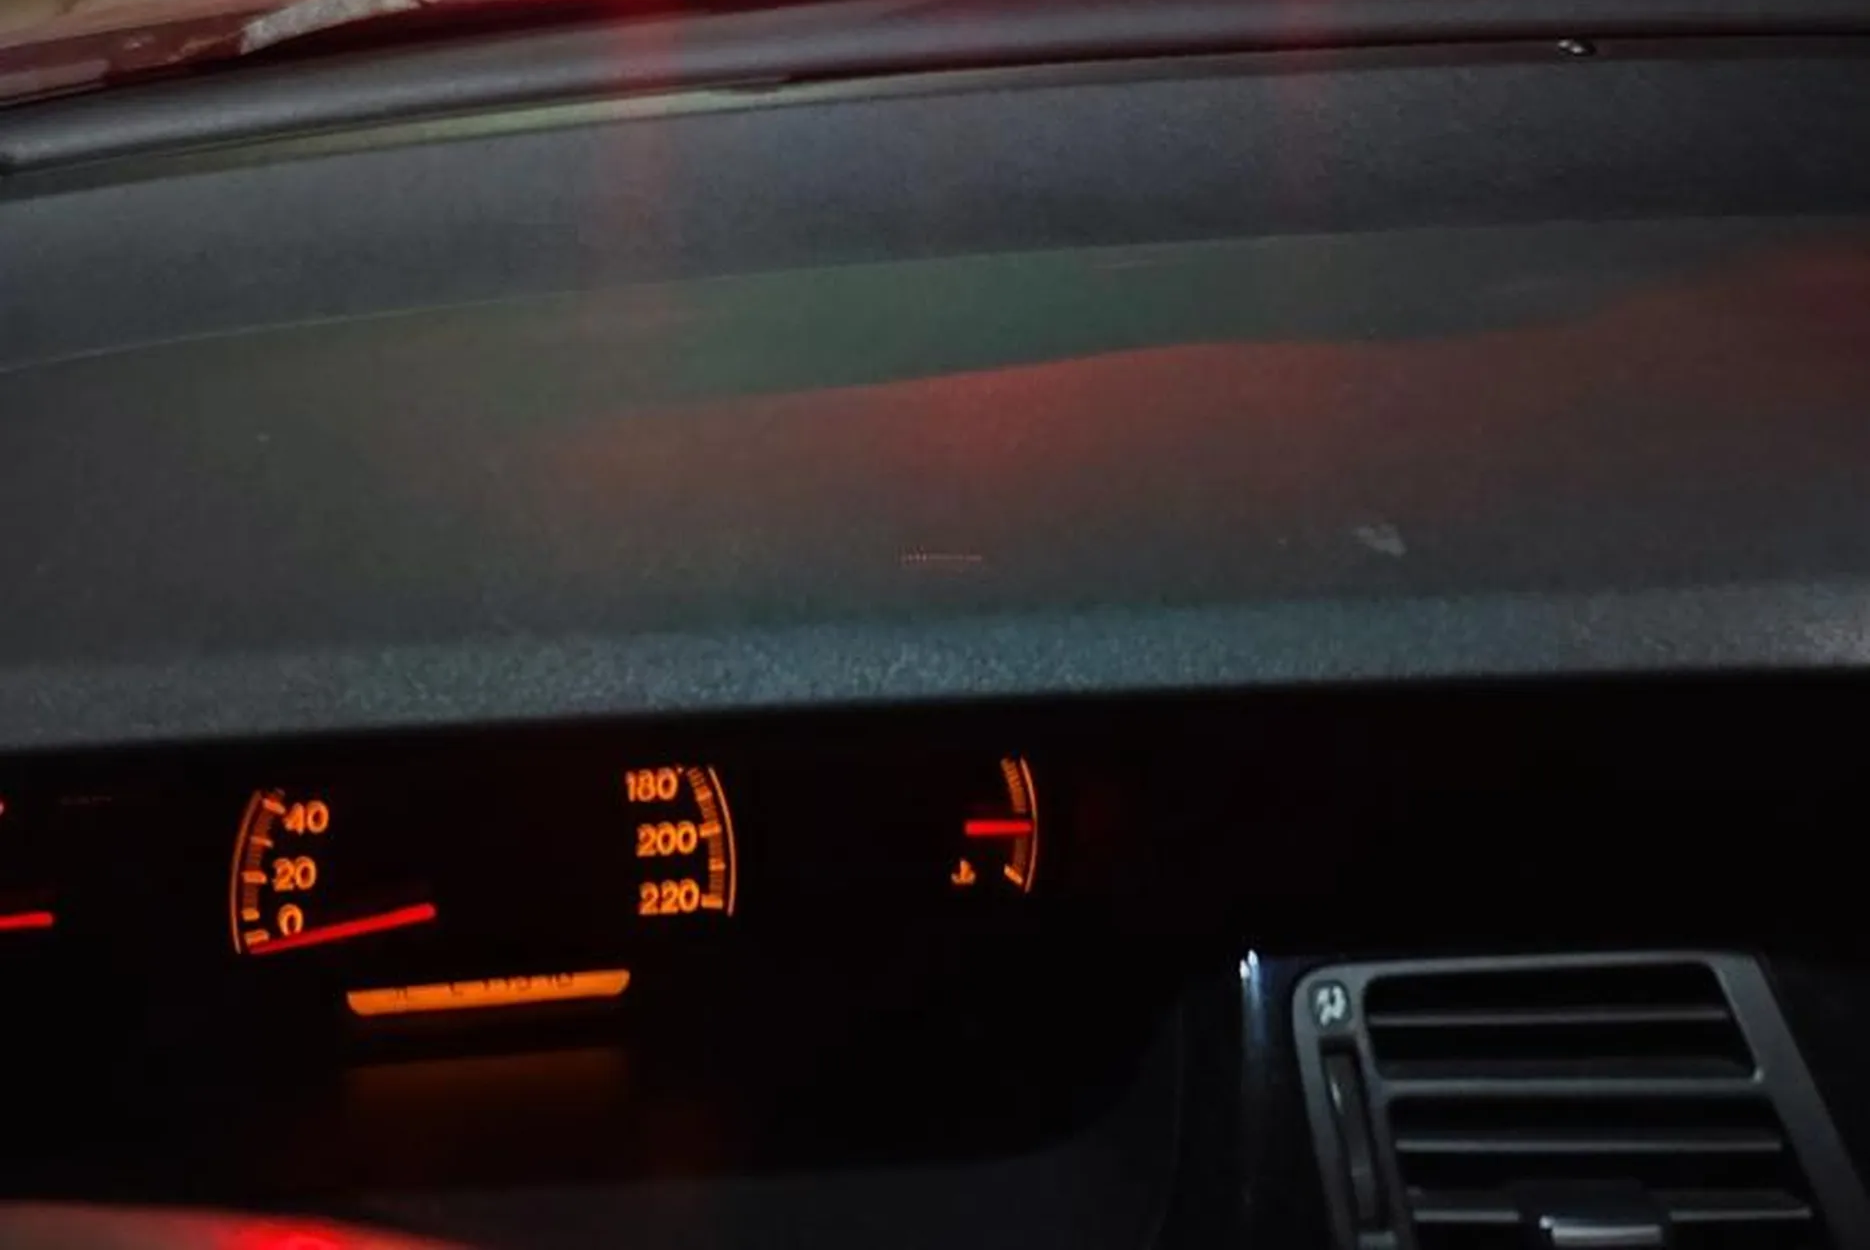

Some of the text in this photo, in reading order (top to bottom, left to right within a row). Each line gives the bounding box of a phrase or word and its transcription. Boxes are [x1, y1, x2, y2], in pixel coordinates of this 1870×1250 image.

[624, 766, 679, 802] 180
[283, 799, 330, 835] 40
[635, 820, 699, 857] 200
[271, 855, 317, 892] 20
[637, 877, 701, 916] 220
[277, 903, 304, 937] 0
